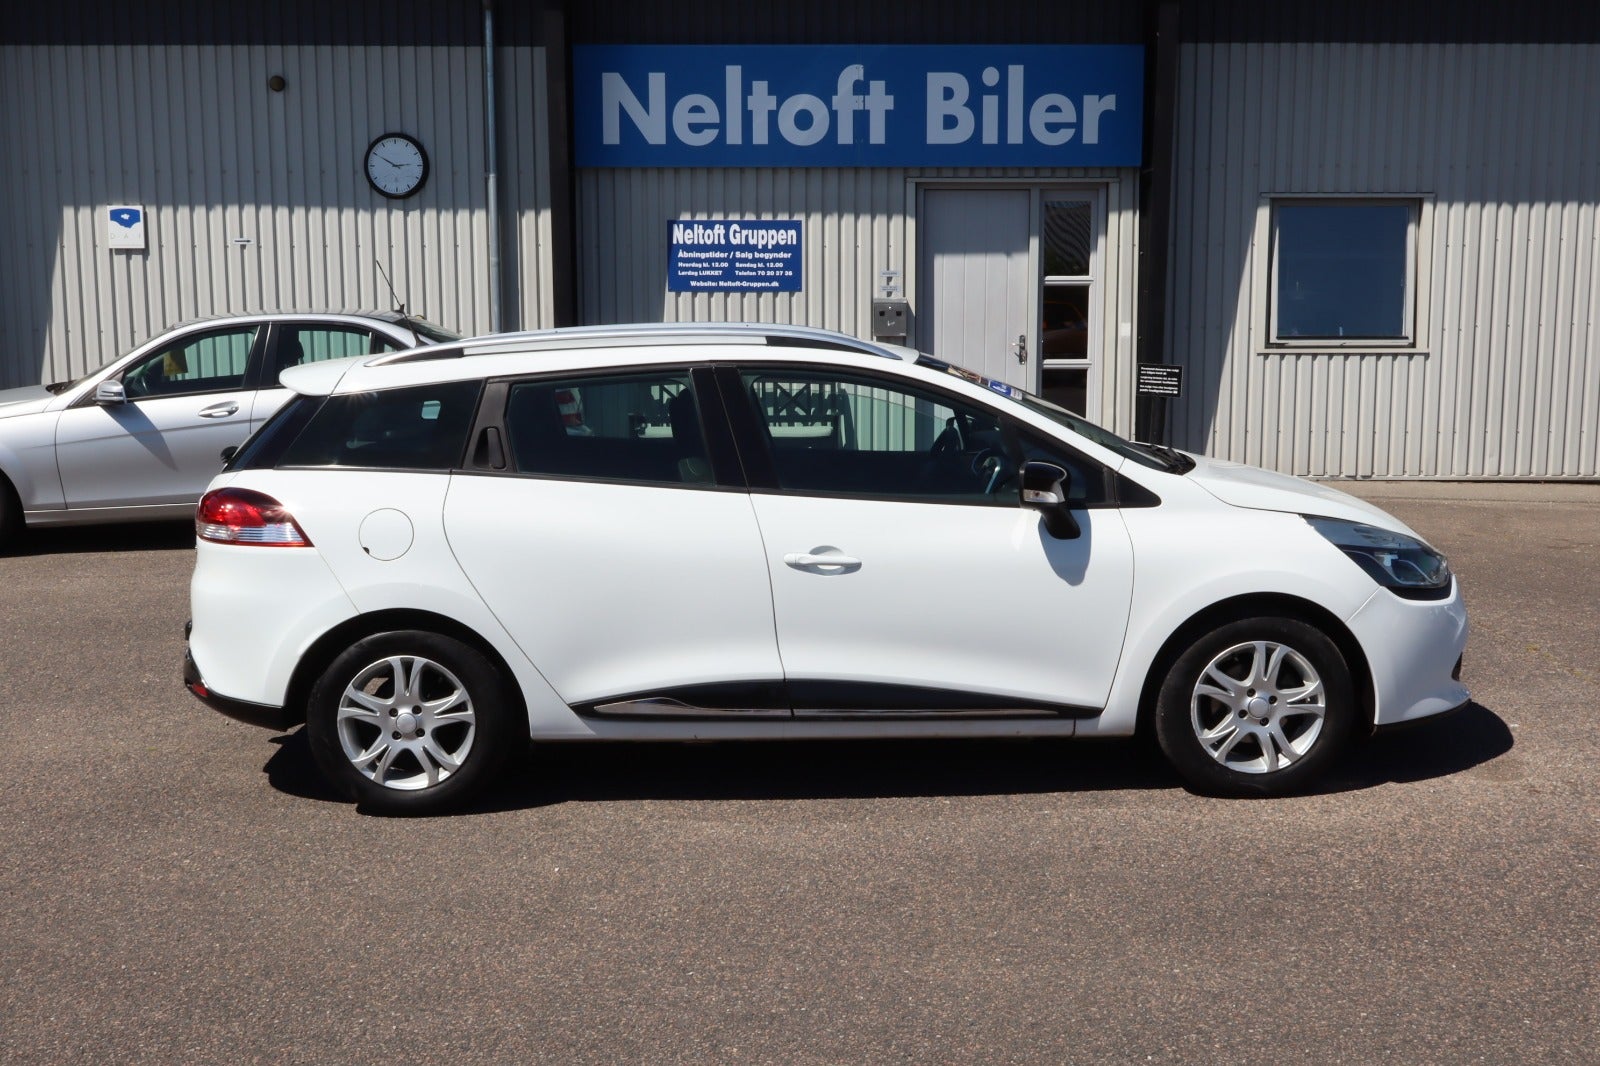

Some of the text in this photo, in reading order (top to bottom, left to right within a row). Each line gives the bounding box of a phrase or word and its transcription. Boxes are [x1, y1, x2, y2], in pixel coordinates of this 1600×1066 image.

[602, 64, 1116, 146] Neltoft Biler
[673, 223, 797, 249] Neltoft Gruppen
[678, 249, 728, 259] Åbningstider
[735, 251, 753, 259] Salg
[754, 251, 792, 259] begynder
[718, 280, 779, 288] Neltoft-Gruppen.dk
